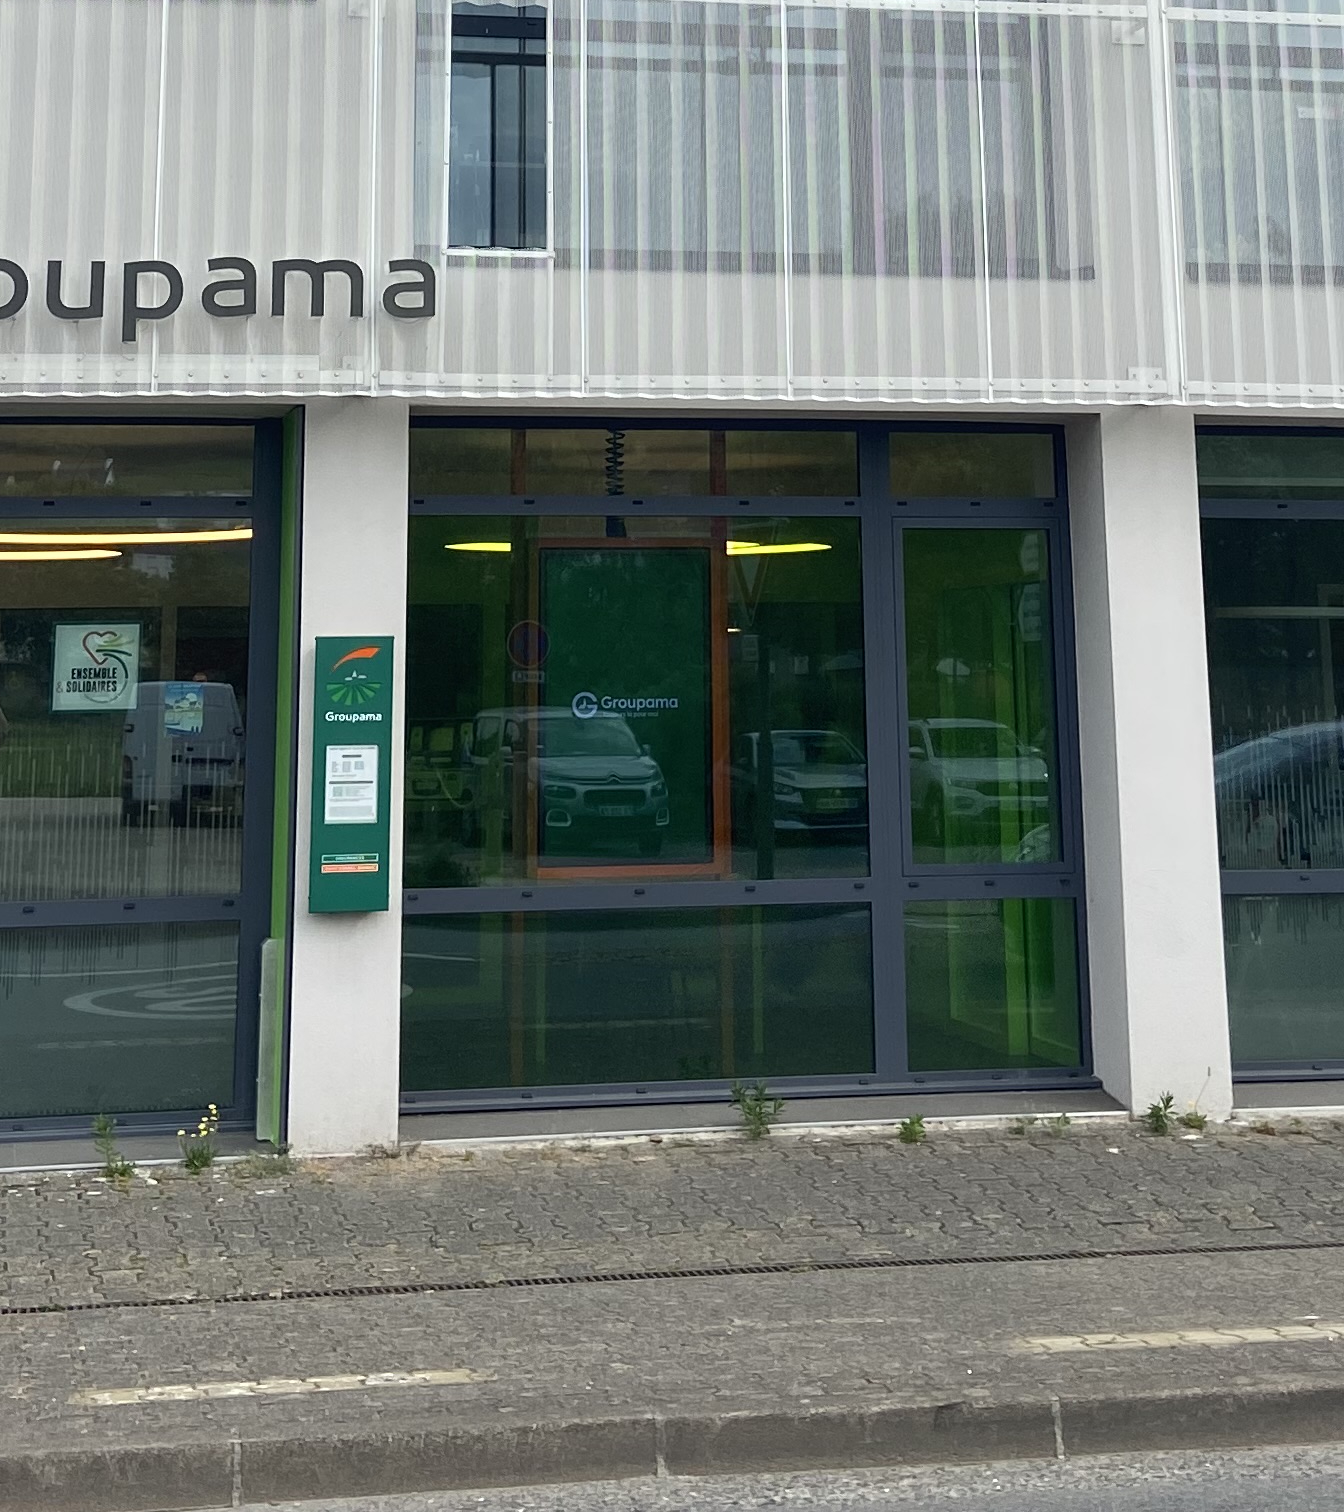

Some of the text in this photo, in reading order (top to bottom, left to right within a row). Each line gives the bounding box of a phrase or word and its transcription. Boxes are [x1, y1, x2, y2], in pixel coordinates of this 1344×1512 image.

[71, 667, 118, 680] ENSEMBLE
[66, 680, 118, 693] SOLIDAIRES
[601, 696, 679, 712] Groupama
[325, 711, 383, 724] Groupama
